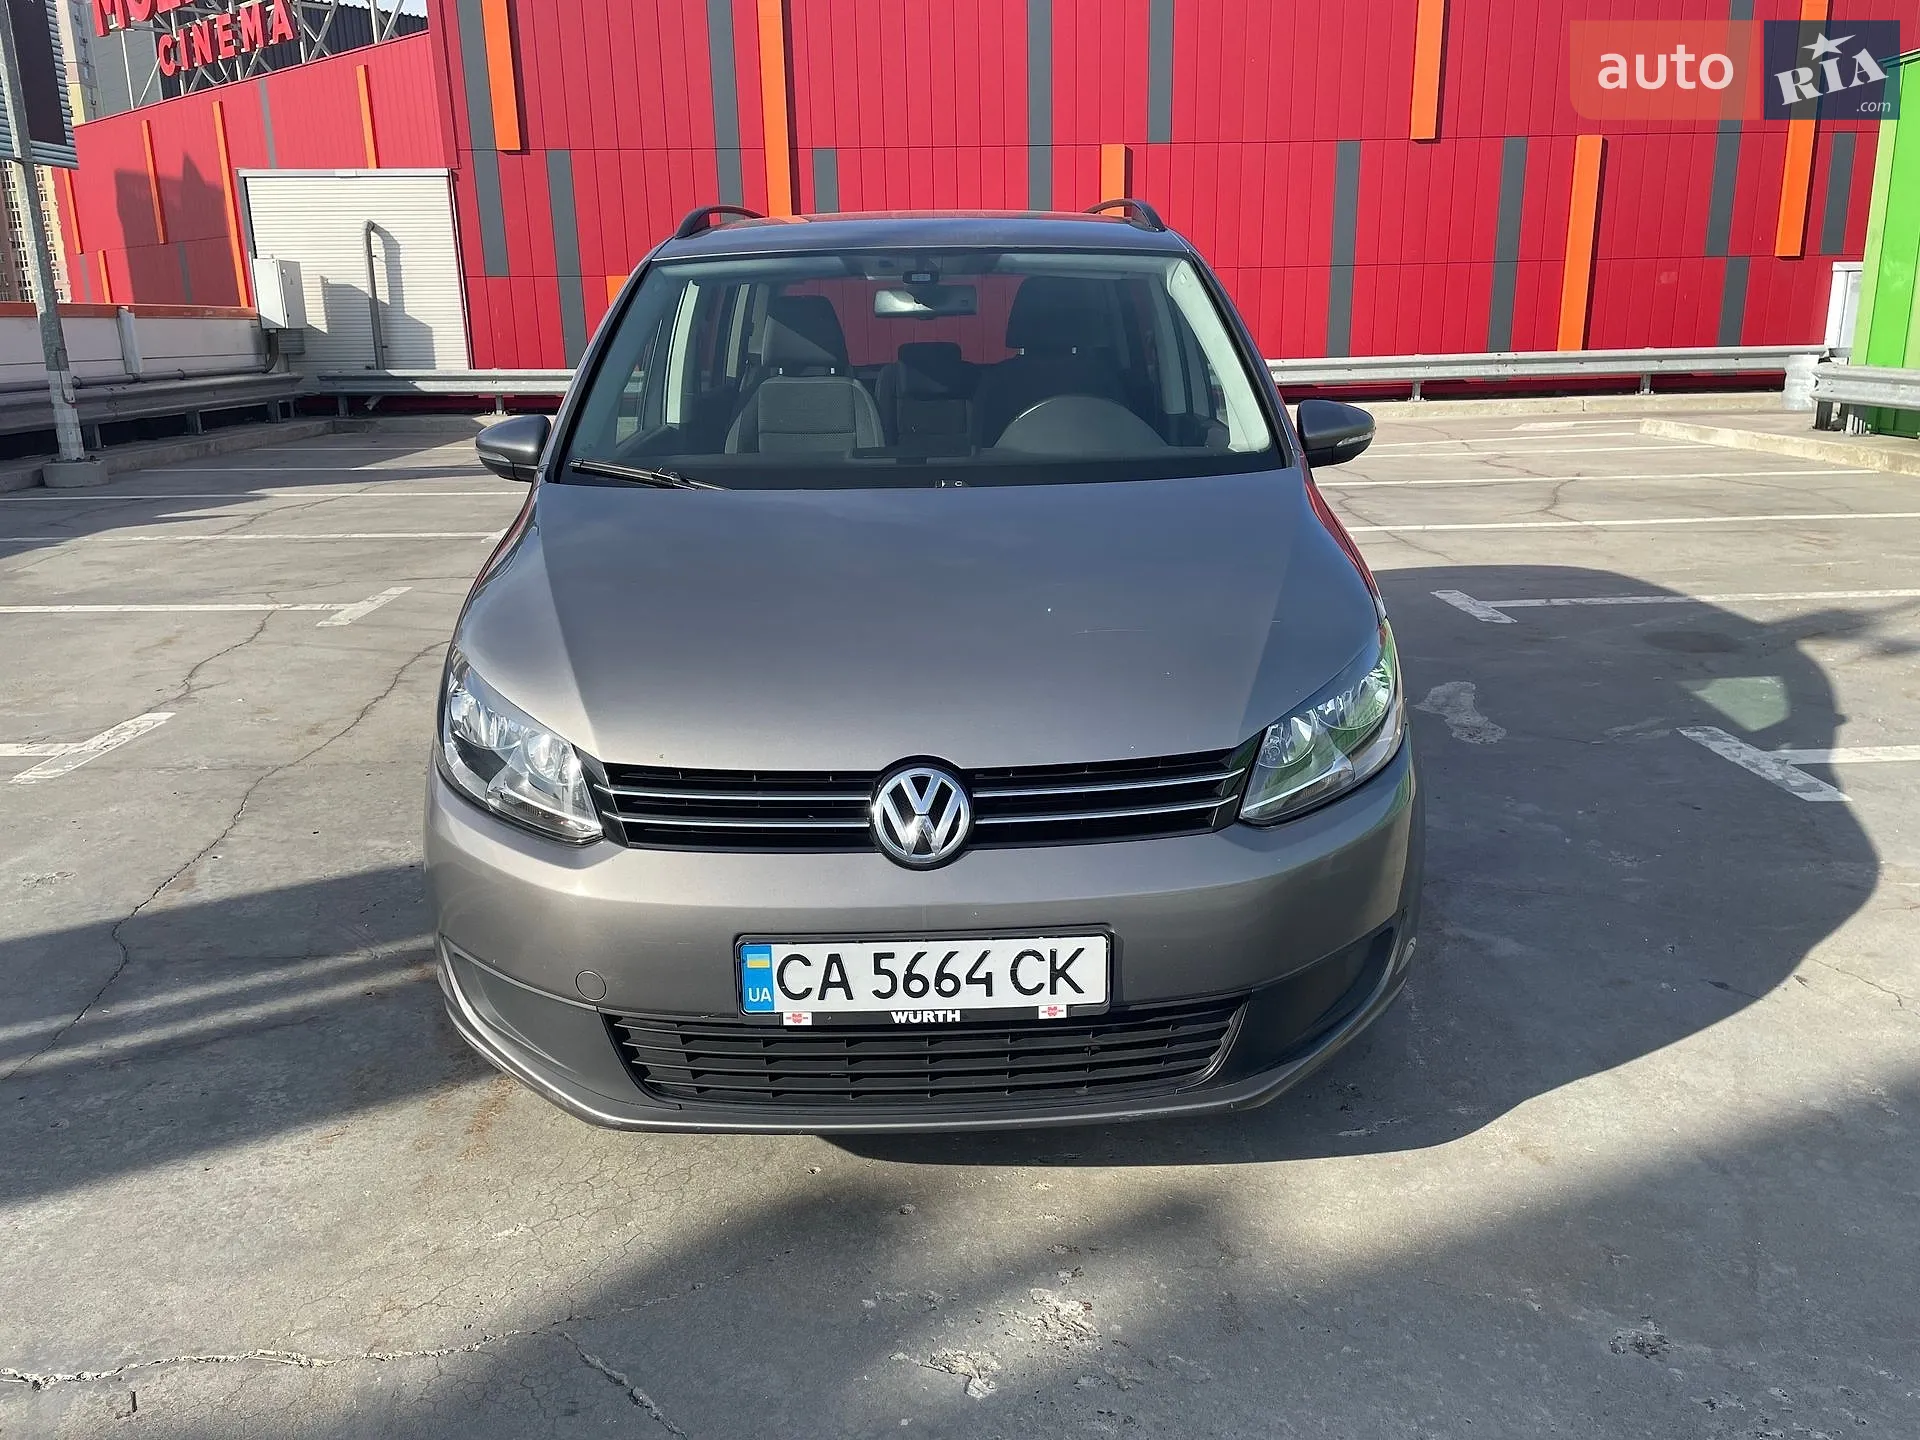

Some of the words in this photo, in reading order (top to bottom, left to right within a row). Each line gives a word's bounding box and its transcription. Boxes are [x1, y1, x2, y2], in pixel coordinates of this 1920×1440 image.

[158, 0, 296, 76] CINEMA
[748, 987, 771, 1002] UA
[776, 952, 854, 1001] CA
[871, 950, 993, 1000] 5664
[1009, 947, 1086, 997] CK
